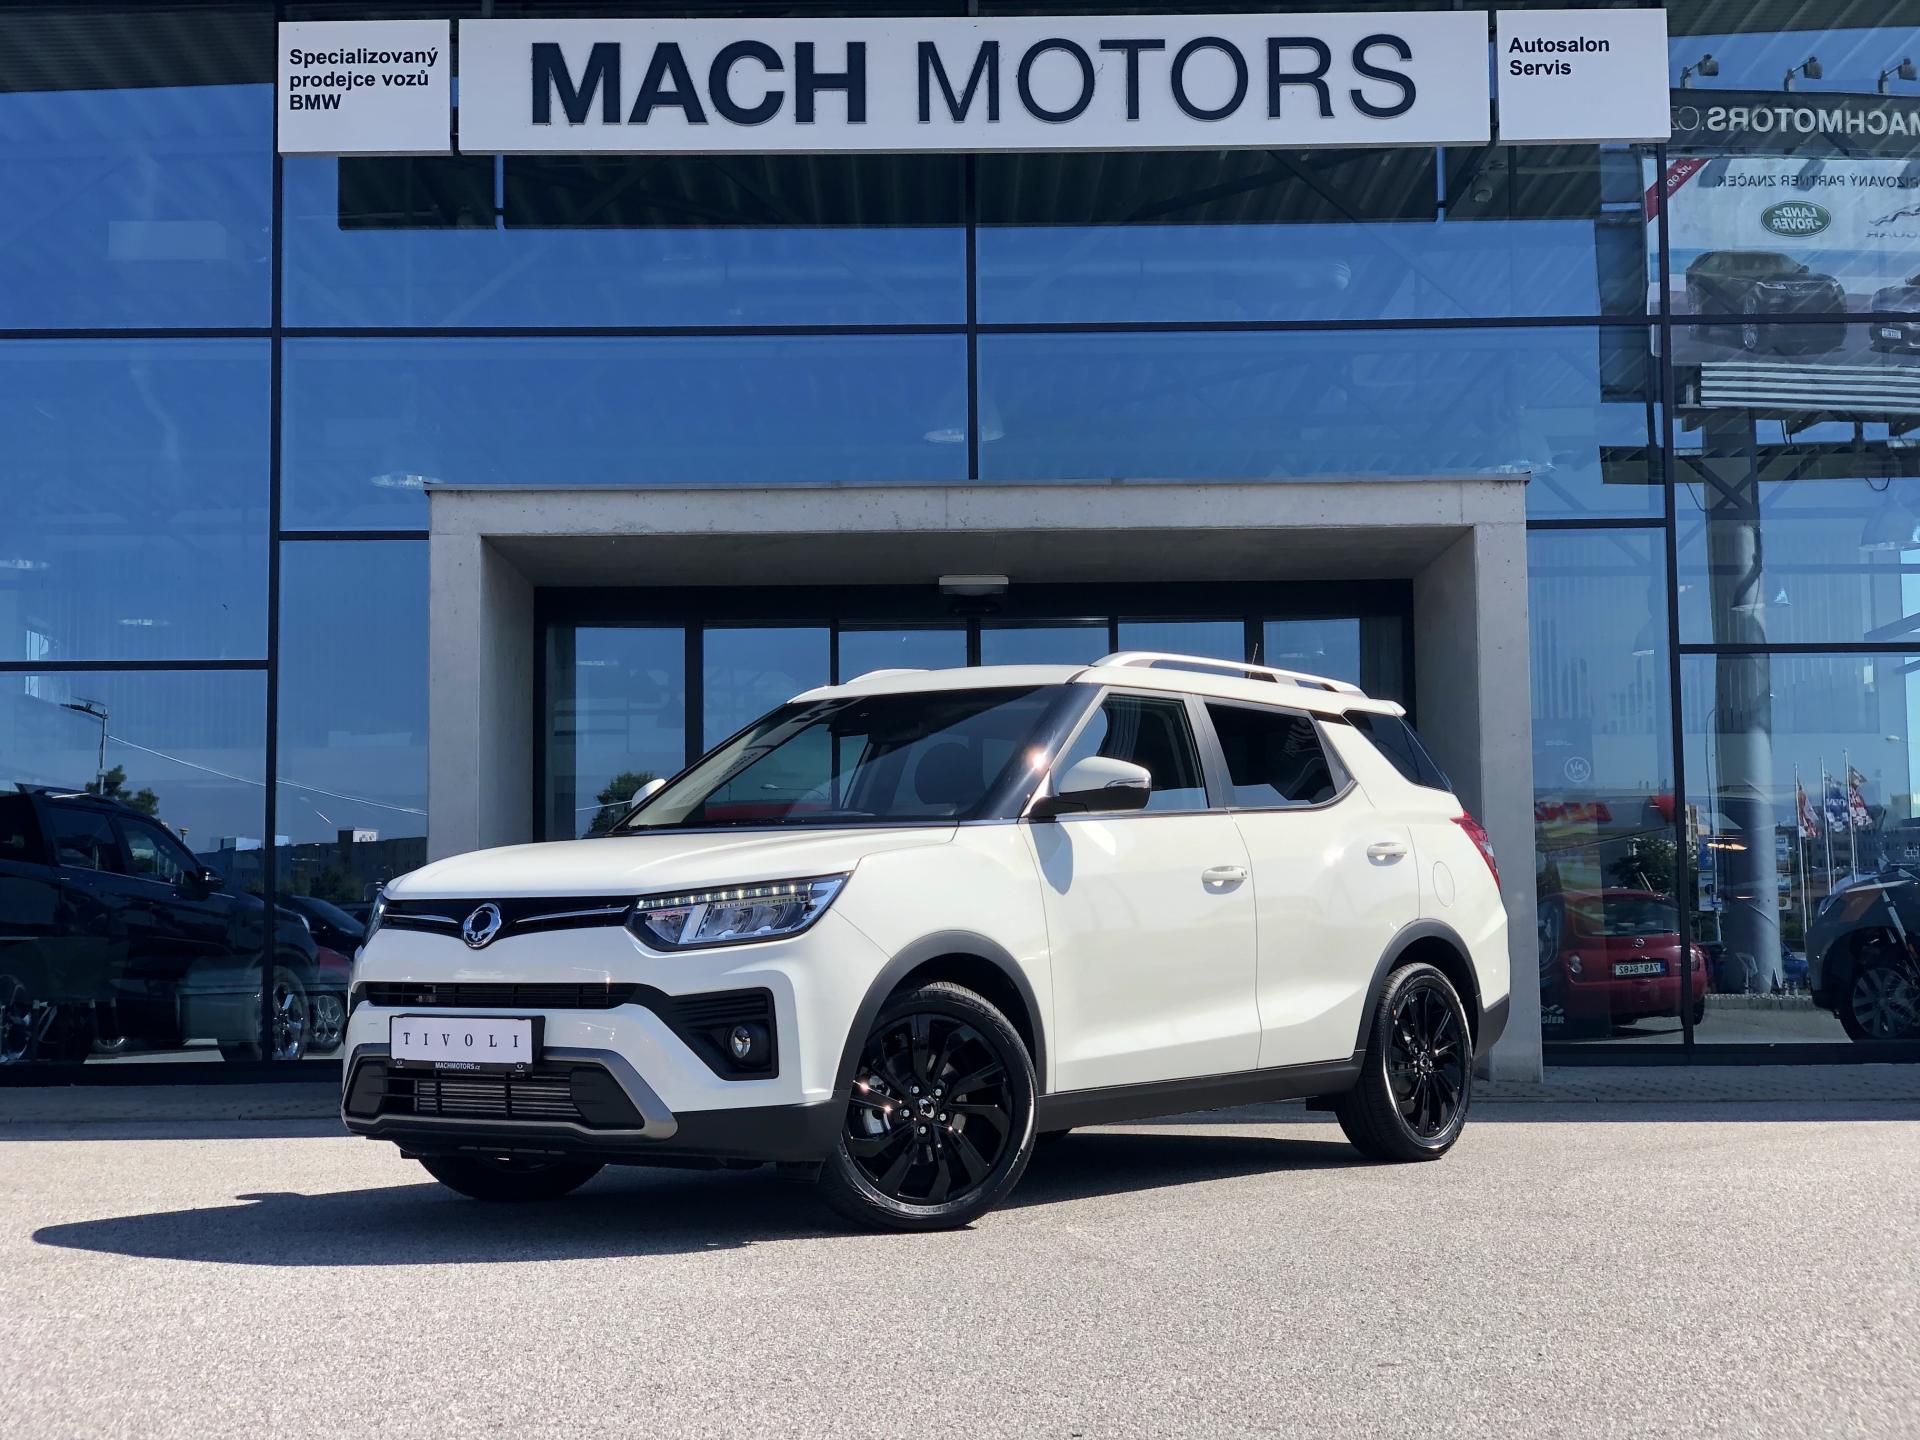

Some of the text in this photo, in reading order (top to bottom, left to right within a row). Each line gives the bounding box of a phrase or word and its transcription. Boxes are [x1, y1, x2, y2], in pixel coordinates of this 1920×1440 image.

[1509, 37, 1609, 53] Autosalon
[290, 47, 438, 68] Specializovaný
[1510, 60, 1571, 75] Servis
[290, 70, 428, 91] prodejce vozů
[531, 33, 1417, 126] MACH MOTORS
[290, 94, 341, 110] BMW
[435, 1061, 480, 1070] MACHMOTORS.cz
